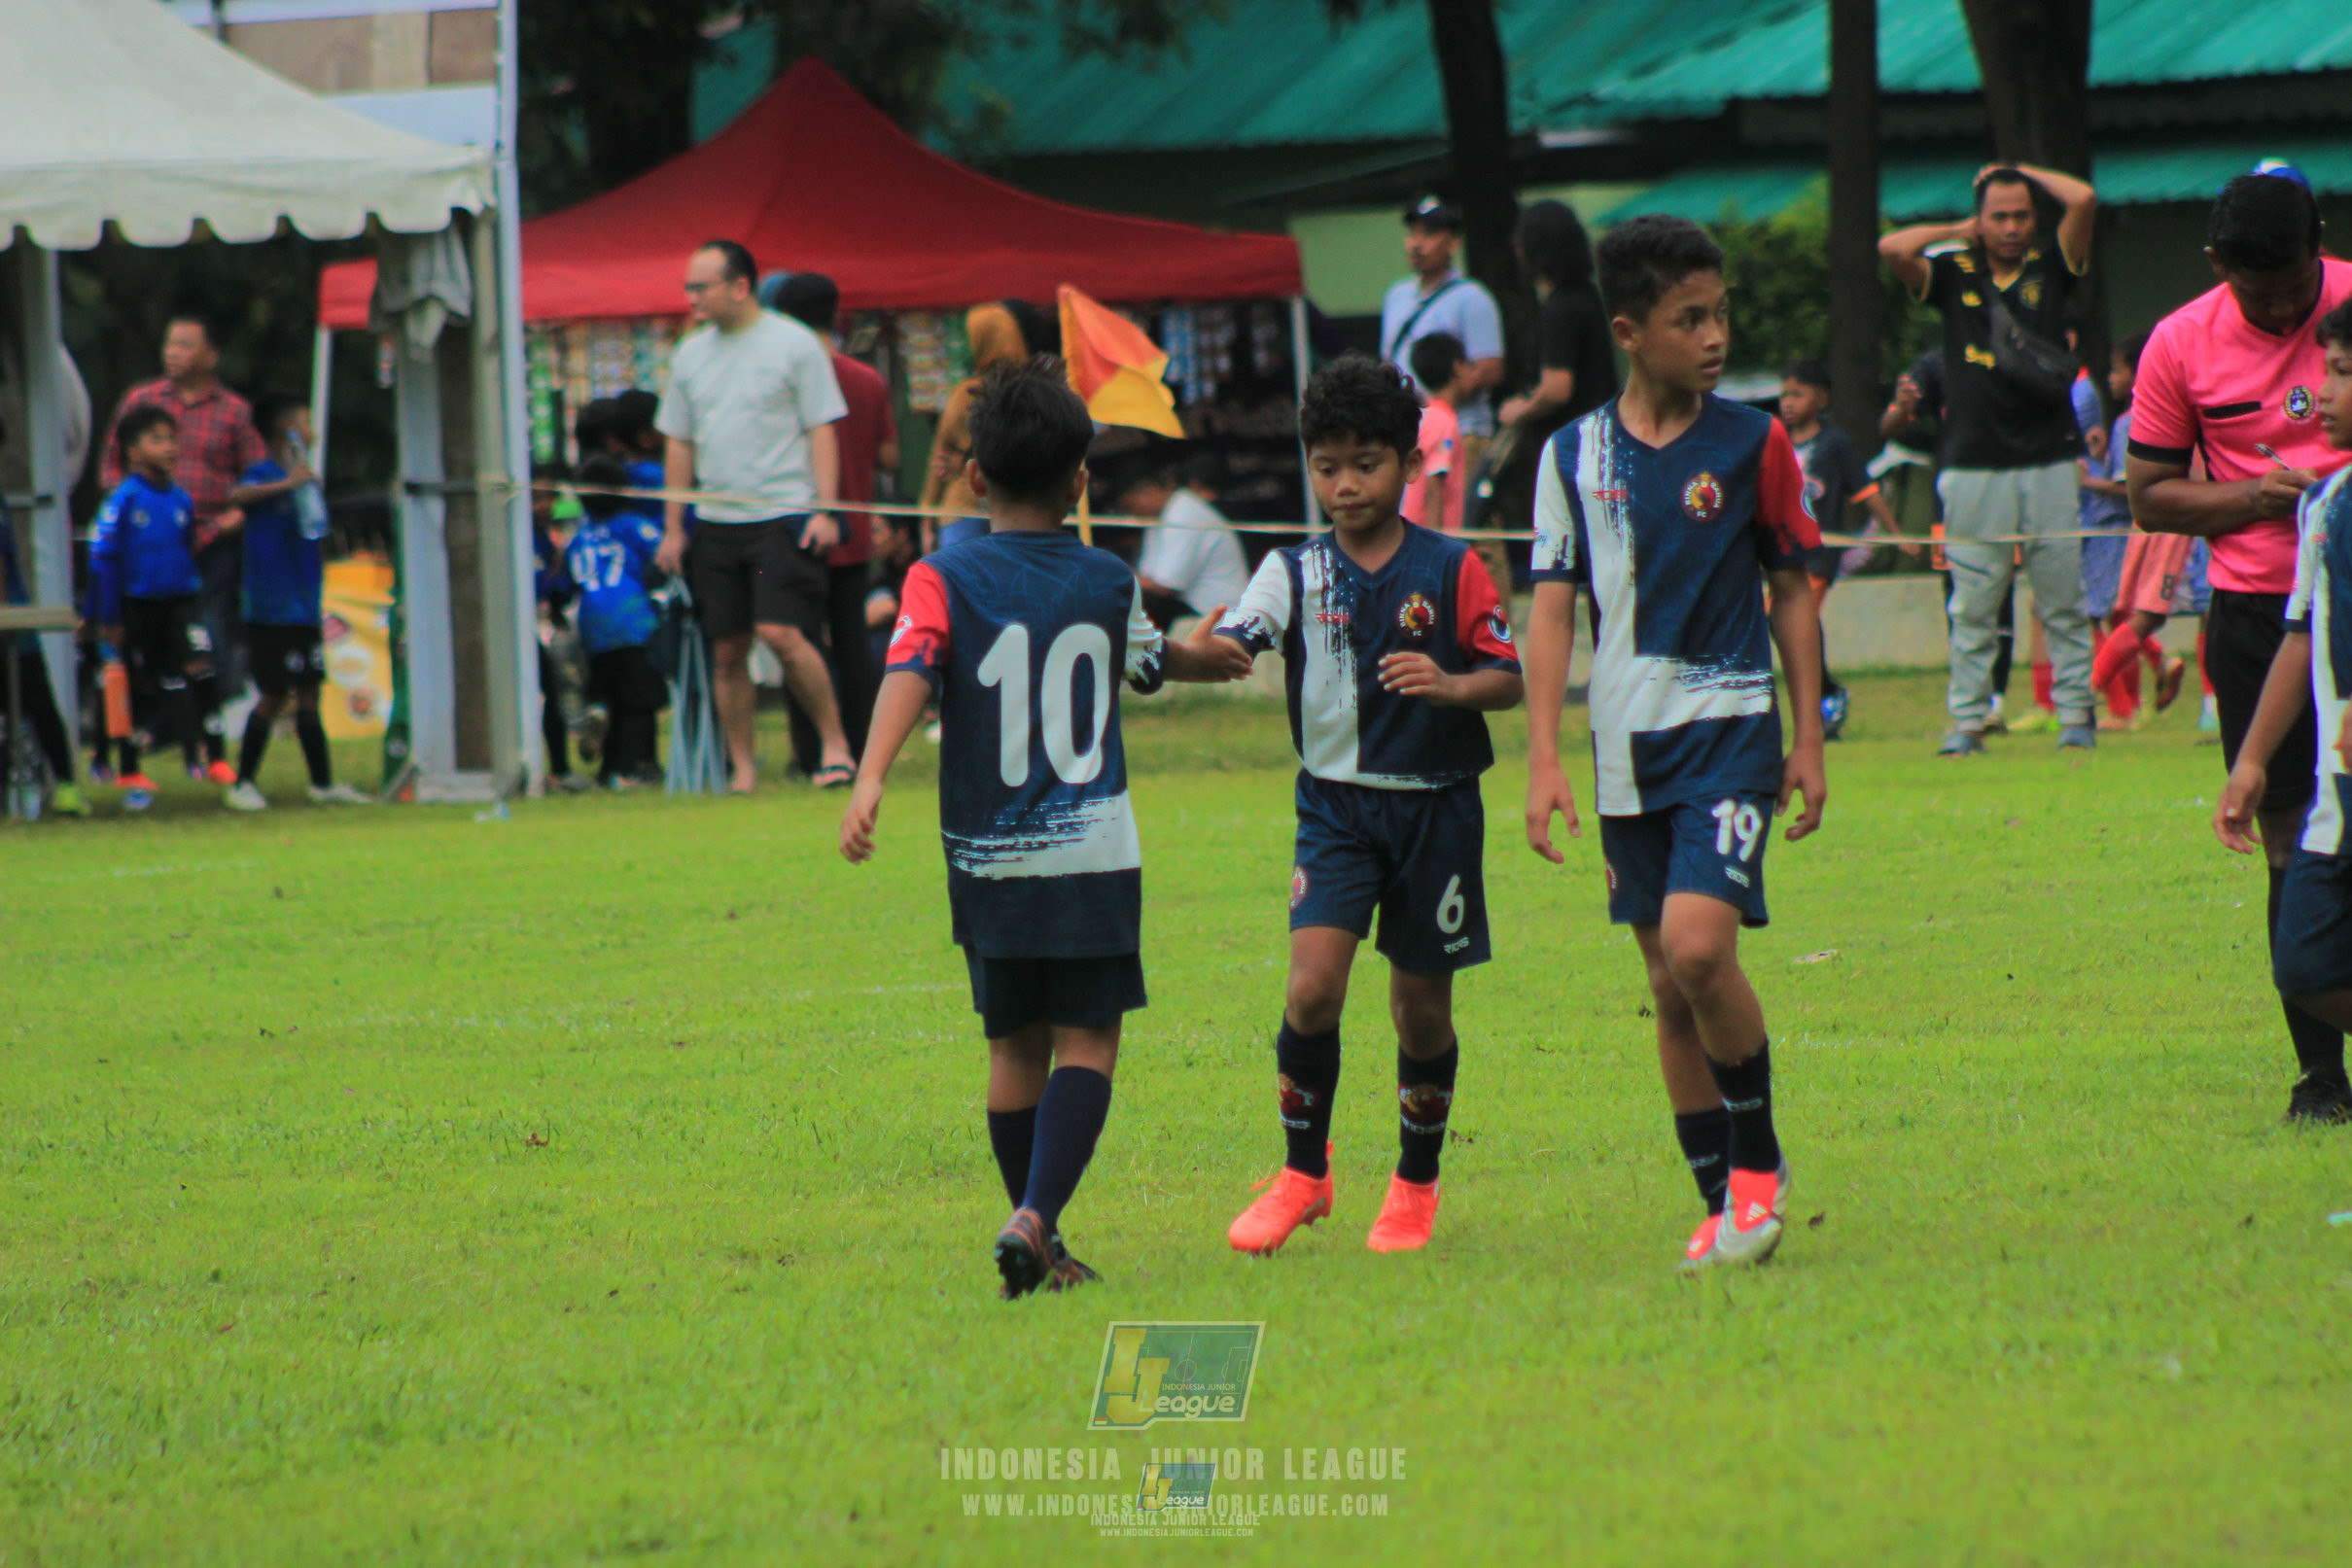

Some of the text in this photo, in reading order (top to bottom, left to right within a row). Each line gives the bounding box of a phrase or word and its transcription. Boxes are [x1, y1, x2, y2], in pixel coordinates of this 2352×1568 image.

[572, 542, 624, 592] 47
[2160, 574, 2175, 601] 8
[978, 623, 1110, 787] 10
[1711, 800, 1762, 862] 19
[1436, 874, 1464, 934] 6
